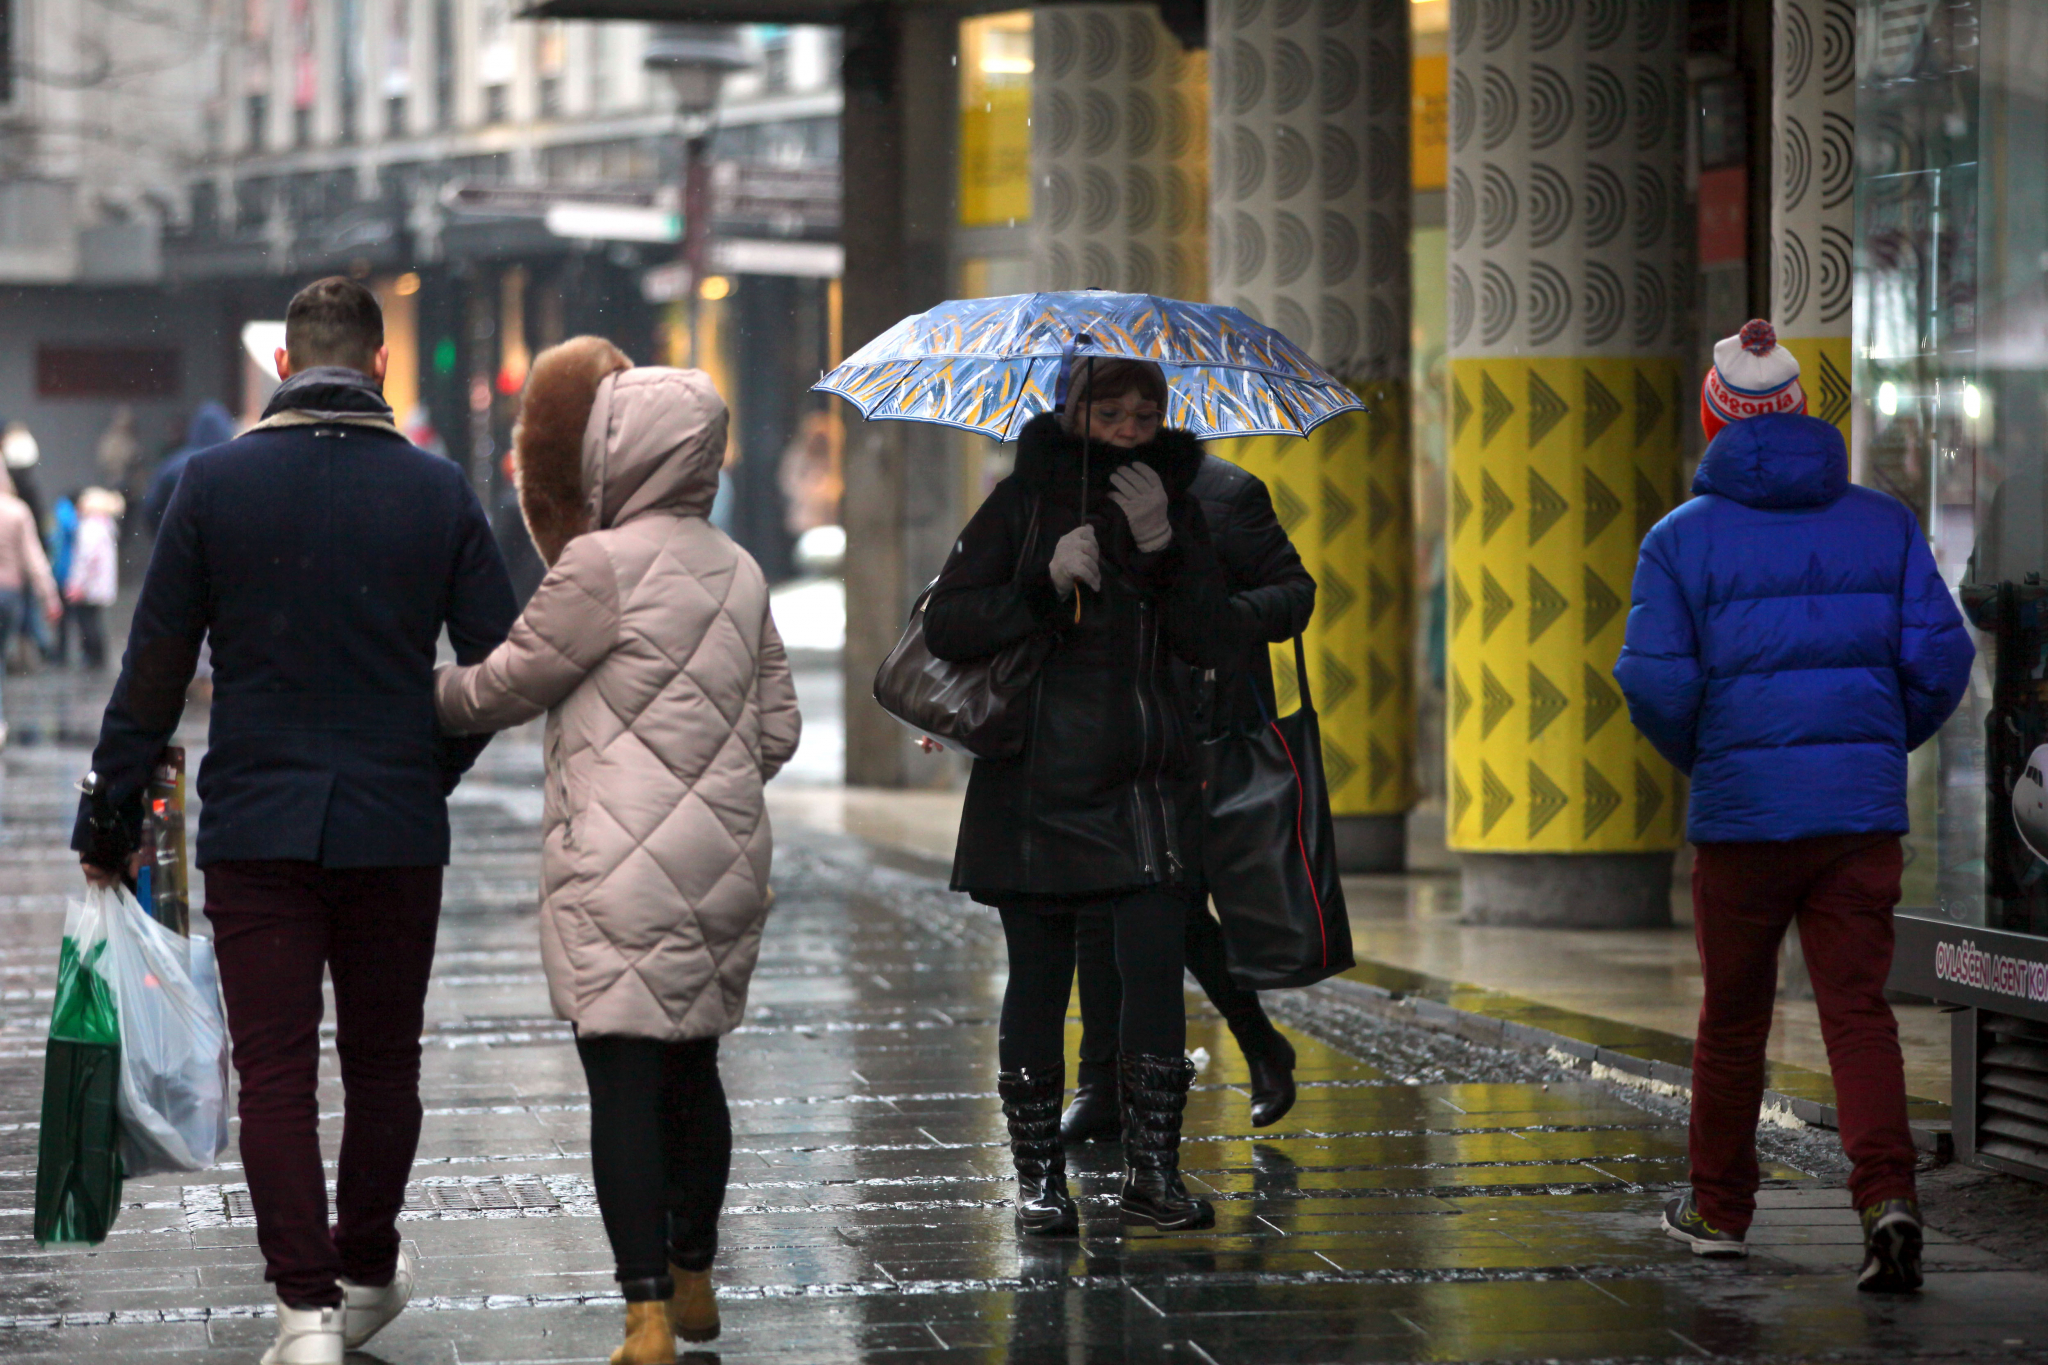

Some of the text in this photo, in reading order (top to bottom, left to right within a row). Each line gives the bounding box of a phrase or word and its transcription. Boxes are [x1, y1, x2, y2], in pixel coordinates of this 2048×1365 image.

[1935, 939, 2048, 1003] OVLAŠĆENI AGENT KO
